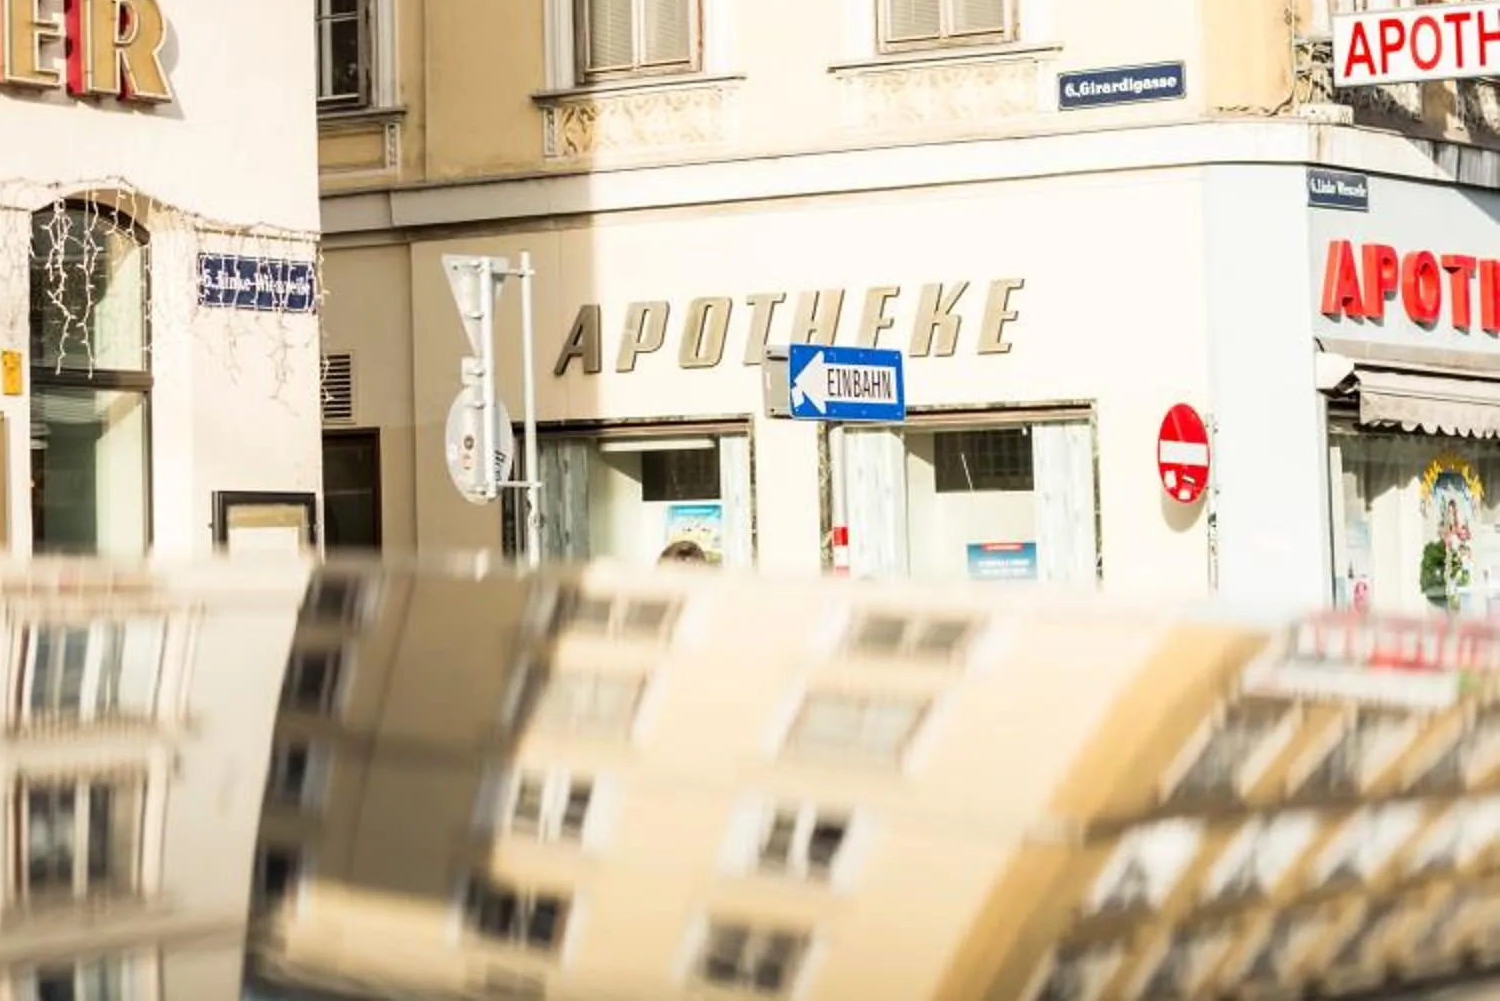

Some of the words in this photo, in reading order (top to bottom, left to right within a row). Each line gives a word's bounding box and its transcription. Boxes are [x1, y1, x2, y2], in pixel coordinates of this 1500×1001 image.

[1344, 11, 1500, 78] APOTH
[554, 278, 1024, 377] APOTHEKE
[827, 368, 892, 399] EINBAHN
